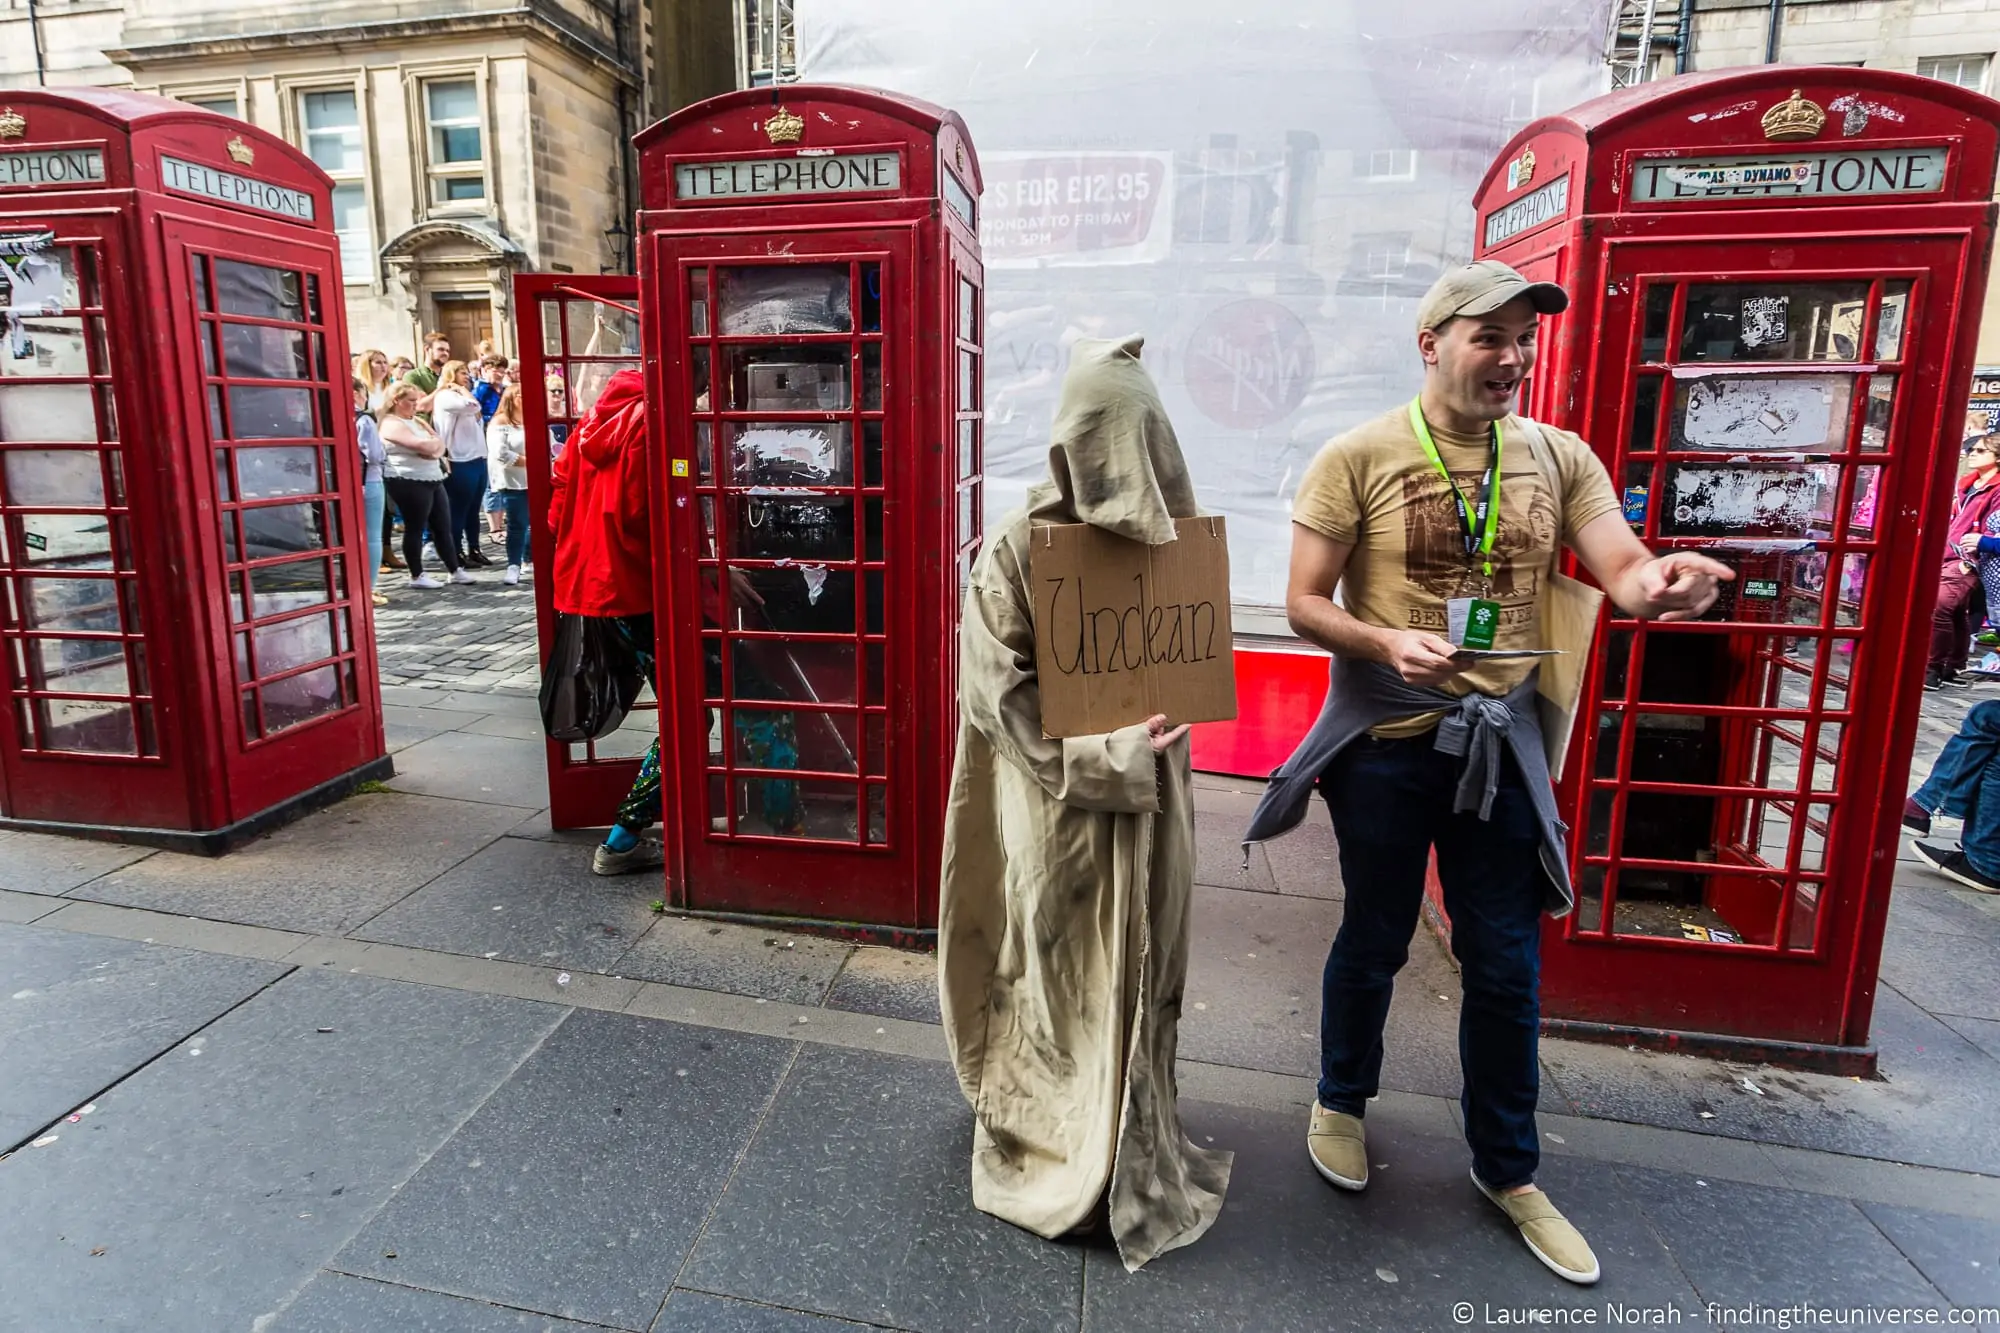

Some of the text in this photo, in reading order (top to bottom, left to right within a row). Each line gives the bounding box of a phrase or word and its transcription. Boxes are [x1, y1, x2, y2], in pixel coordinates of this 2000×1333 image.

[166, 160, 308, 217] TELEPHONE
[683, 157, 890, 196] TELEPHONE
[1017, 177, 1060, 207] FOR
[1067, 172, 1151, 205] £12.95
[1743, 167, 1792, 183] DYNAMO
[981, 210, 1132, 232] MONDAY TO FRIDAY
[1490, 180, 1568, 244] TELEPHONE
[1046, 573, 1217, 675] Unclean
